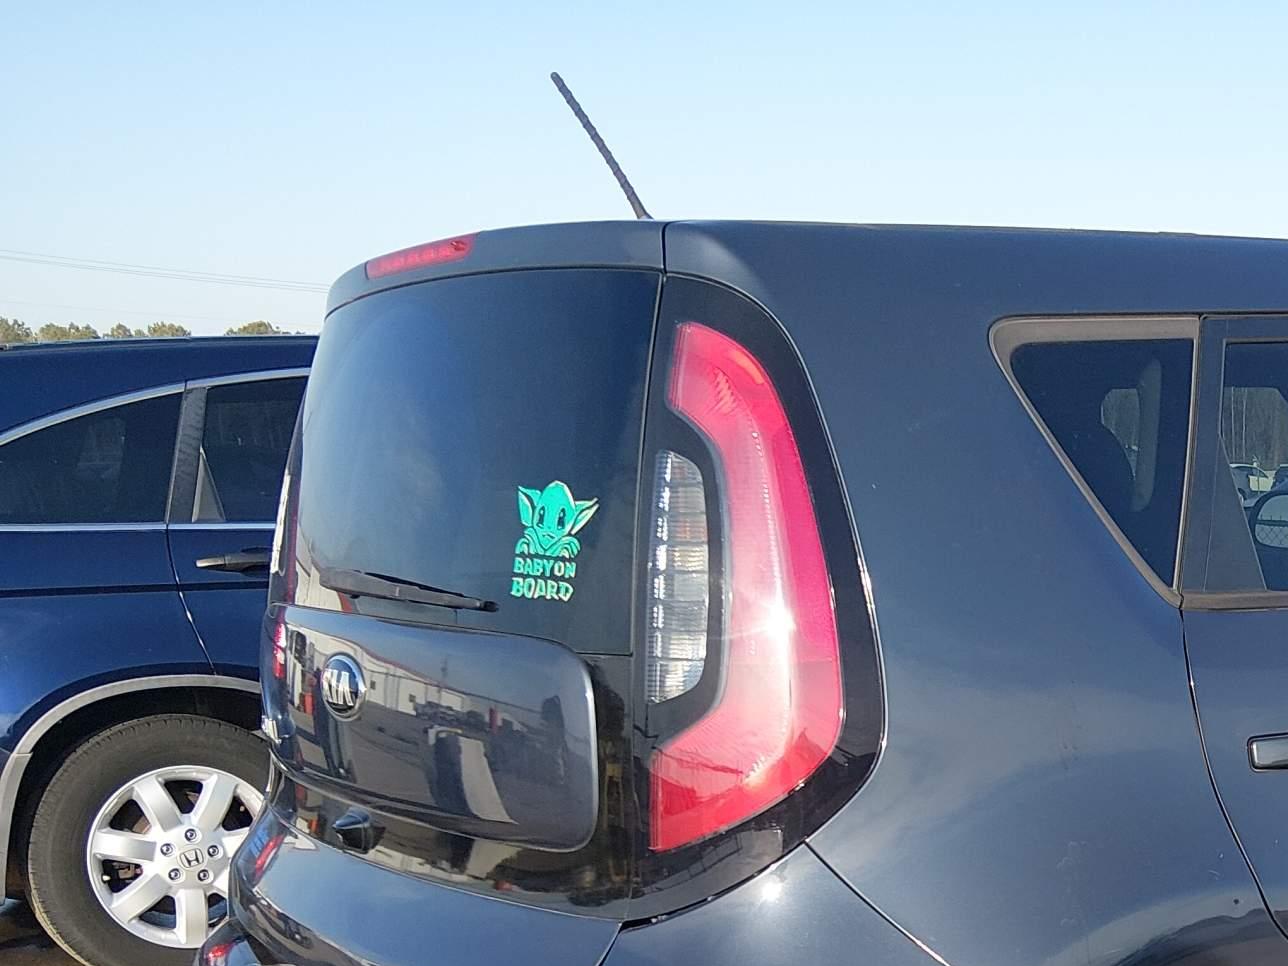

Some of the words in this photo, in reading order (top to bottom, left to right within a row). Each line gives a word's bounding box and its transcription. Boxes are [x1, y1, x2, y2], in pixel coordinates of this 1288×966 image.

[513, 557, 554, 577] BABY
[553, 561, 577, 578] ON
[510, 577, 574, 602] BOARD
[322, 667, 355, 706] KIA
